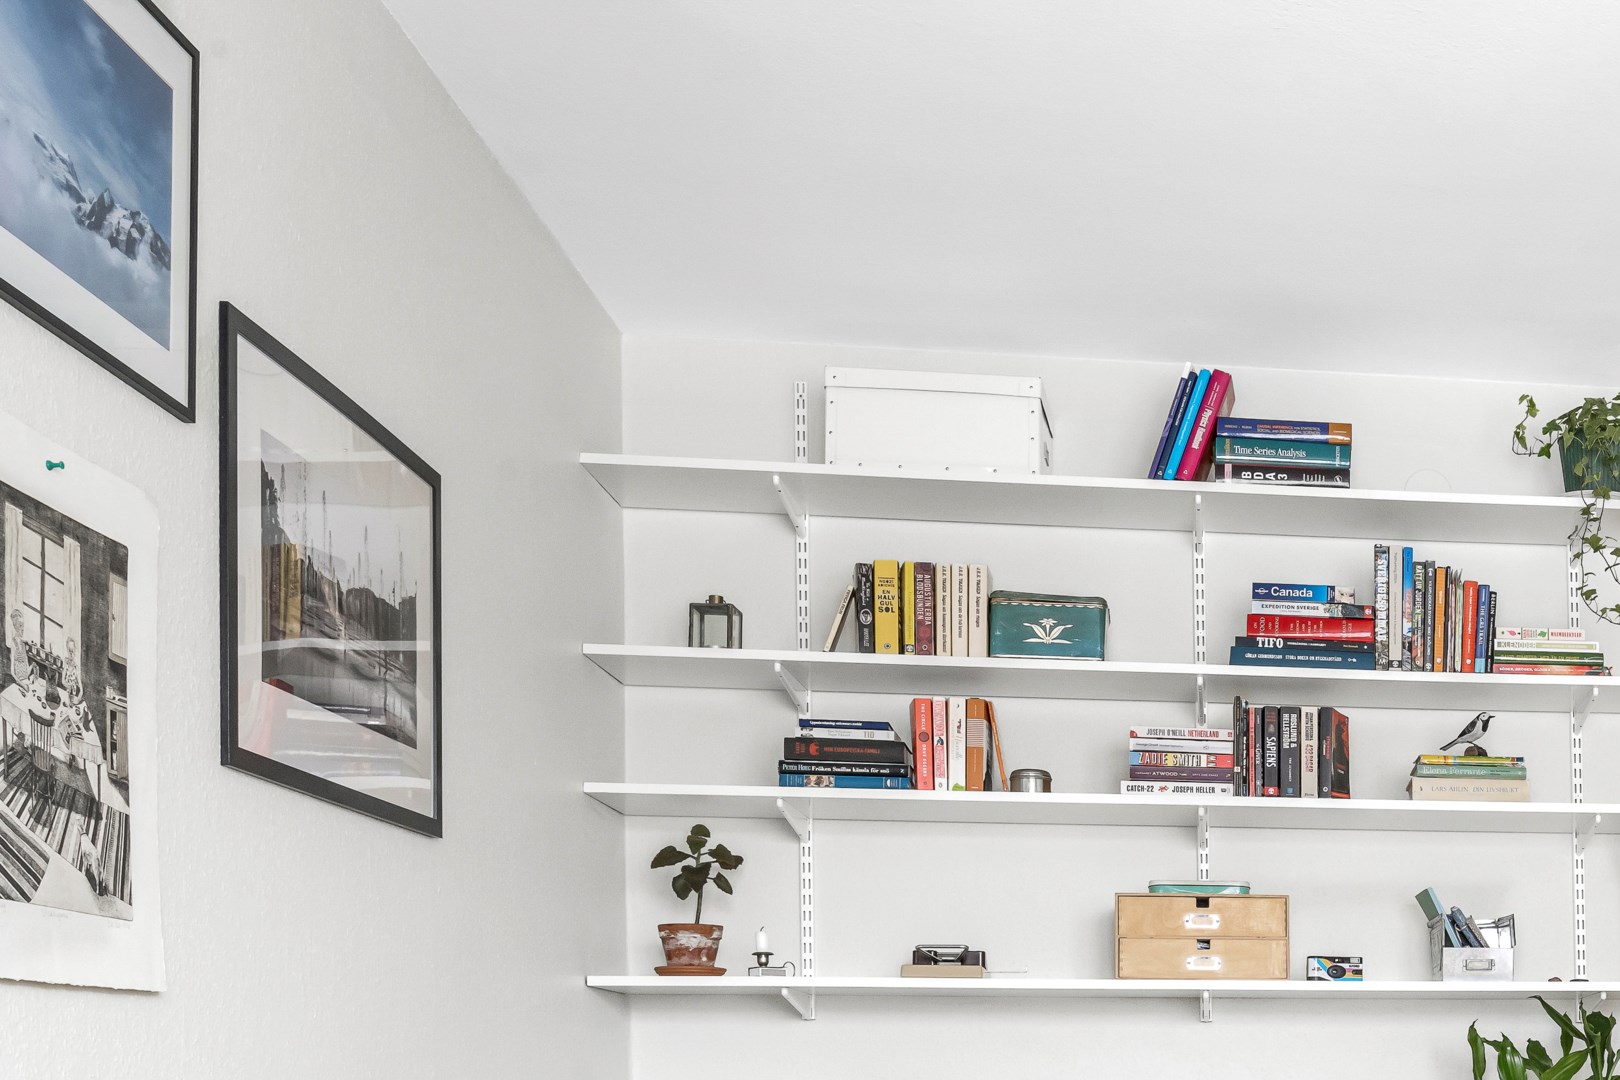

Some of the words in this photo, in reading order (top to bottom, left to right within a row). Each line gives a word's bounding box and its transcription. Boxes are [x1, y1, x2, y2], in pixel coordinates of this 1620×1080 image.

[1200, 409, 1212, 427] Physics
[1234, 445, 1252, 454] Time
[1254, 447, 1276, 455] Series
[1278, 448, 1306, 459] Analysis
[1415, 565, 1423, 581] RÄTT
[916, 574, 924, 620] BLODSBUNDEN
[1271, 586, 1312, 598] Canada
[1256, 637, 1283, 648] TIFO
[1146, 728, 1165, 736] JOSEPH
[1167, 729, 1186, 737] O'NEILL
[1188, 730, 1219, 738] NETHERLAND
[1282, 714, 1290, 748] HELLSTRÖM
[1266, 737, 1276, 767] SAPIENS
[1139, 753, 1168, 765] ZADIE
[1173, 754, 1201, 766] SMITH
[1449, 768, 1486, 776] Ferrante
[1172, 785, 1194, 793] JOSEPH
[1196, 786, 1215, 794] HELLER
